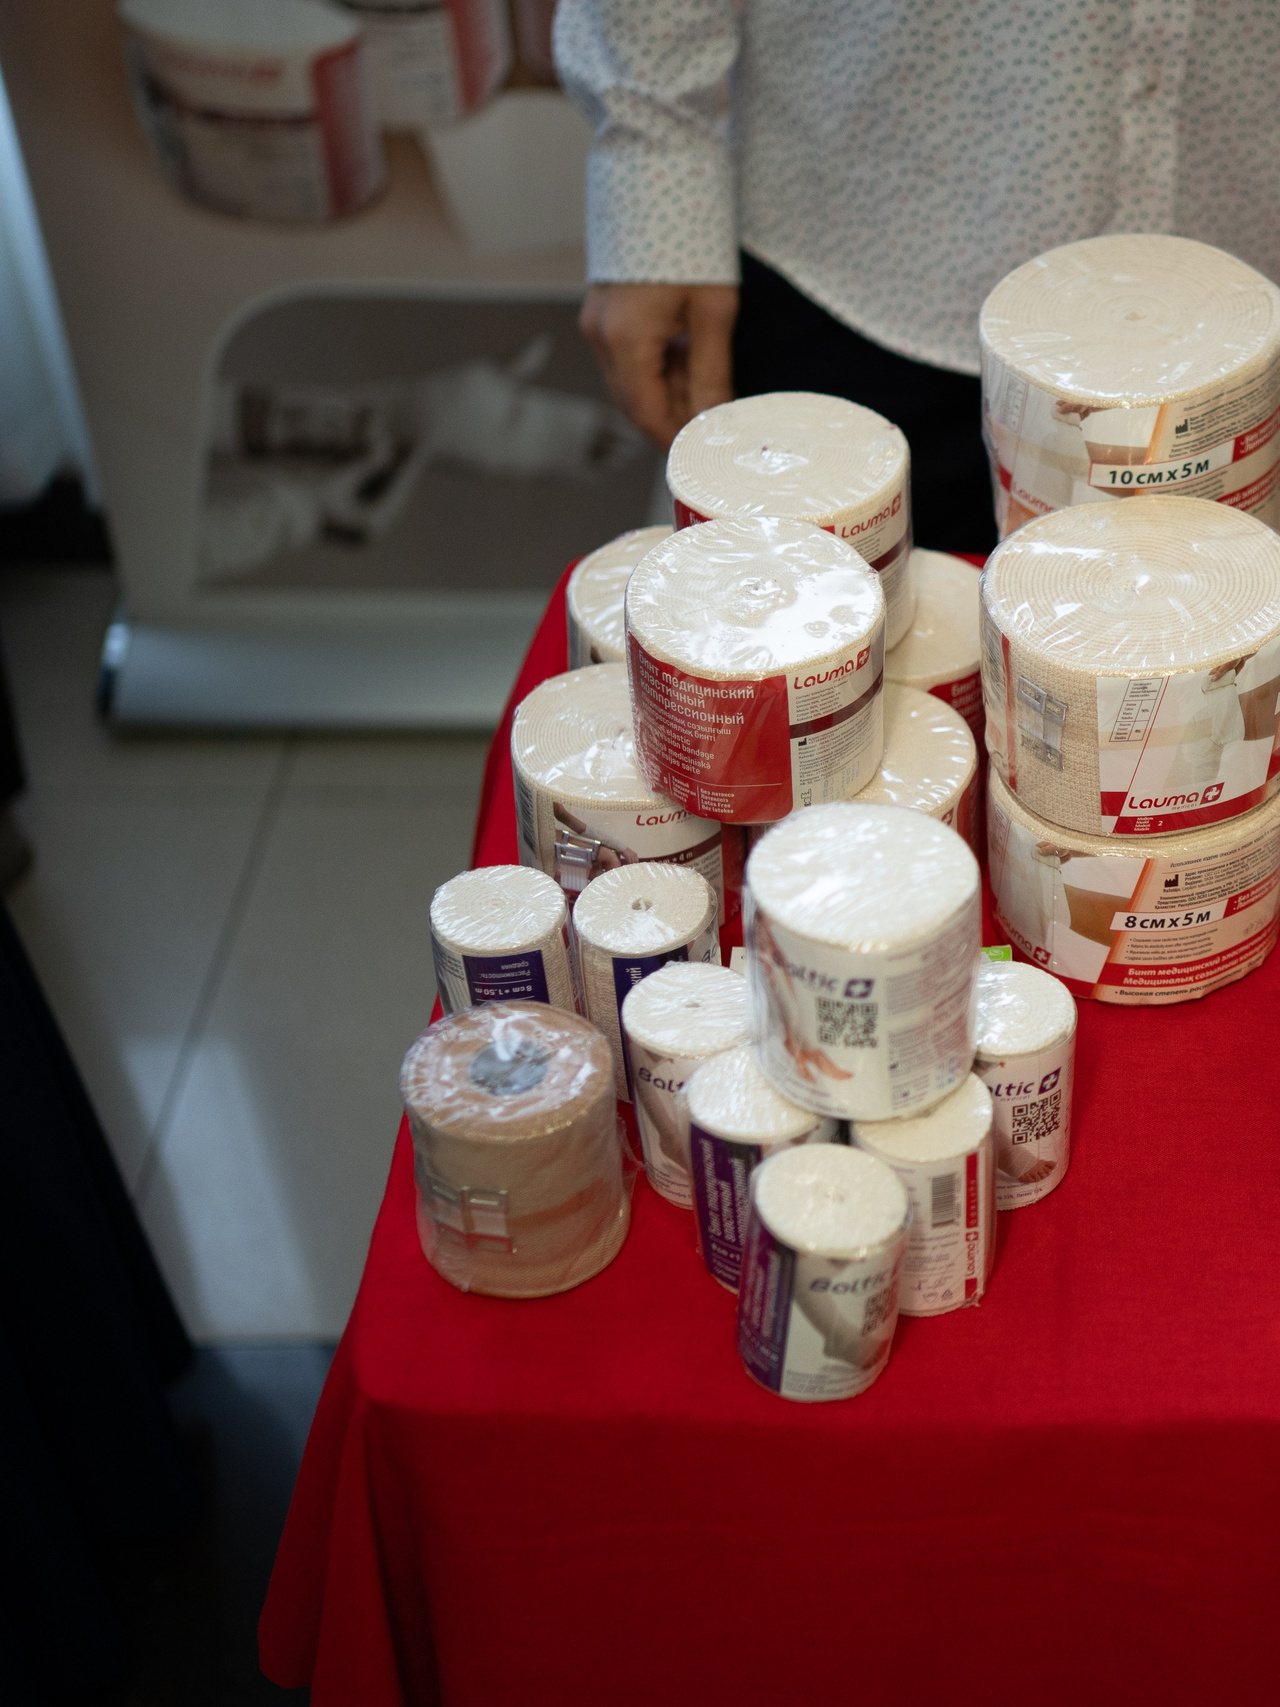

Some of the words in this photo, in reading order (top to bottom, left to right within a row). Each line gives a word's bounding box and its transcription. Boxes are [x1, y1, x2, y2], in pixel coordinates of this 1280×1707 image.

[841, 507, 891, 538] Lauma
[640, 666, 706, 708] эластичный
[662, 671, 755, 699] медицинский
[794, 660, 854, 690] Lauma
[640, 679, 744, 724] компрессионный
[1128, 792, 1199, 810] Lauma
[636, 811, 690, 826] Laum
[1128, 968, 1156, 976] Бинт
[1157, 956, 1220, 976] медицинский
[1123, 975, 1194, 986] Медициналық
